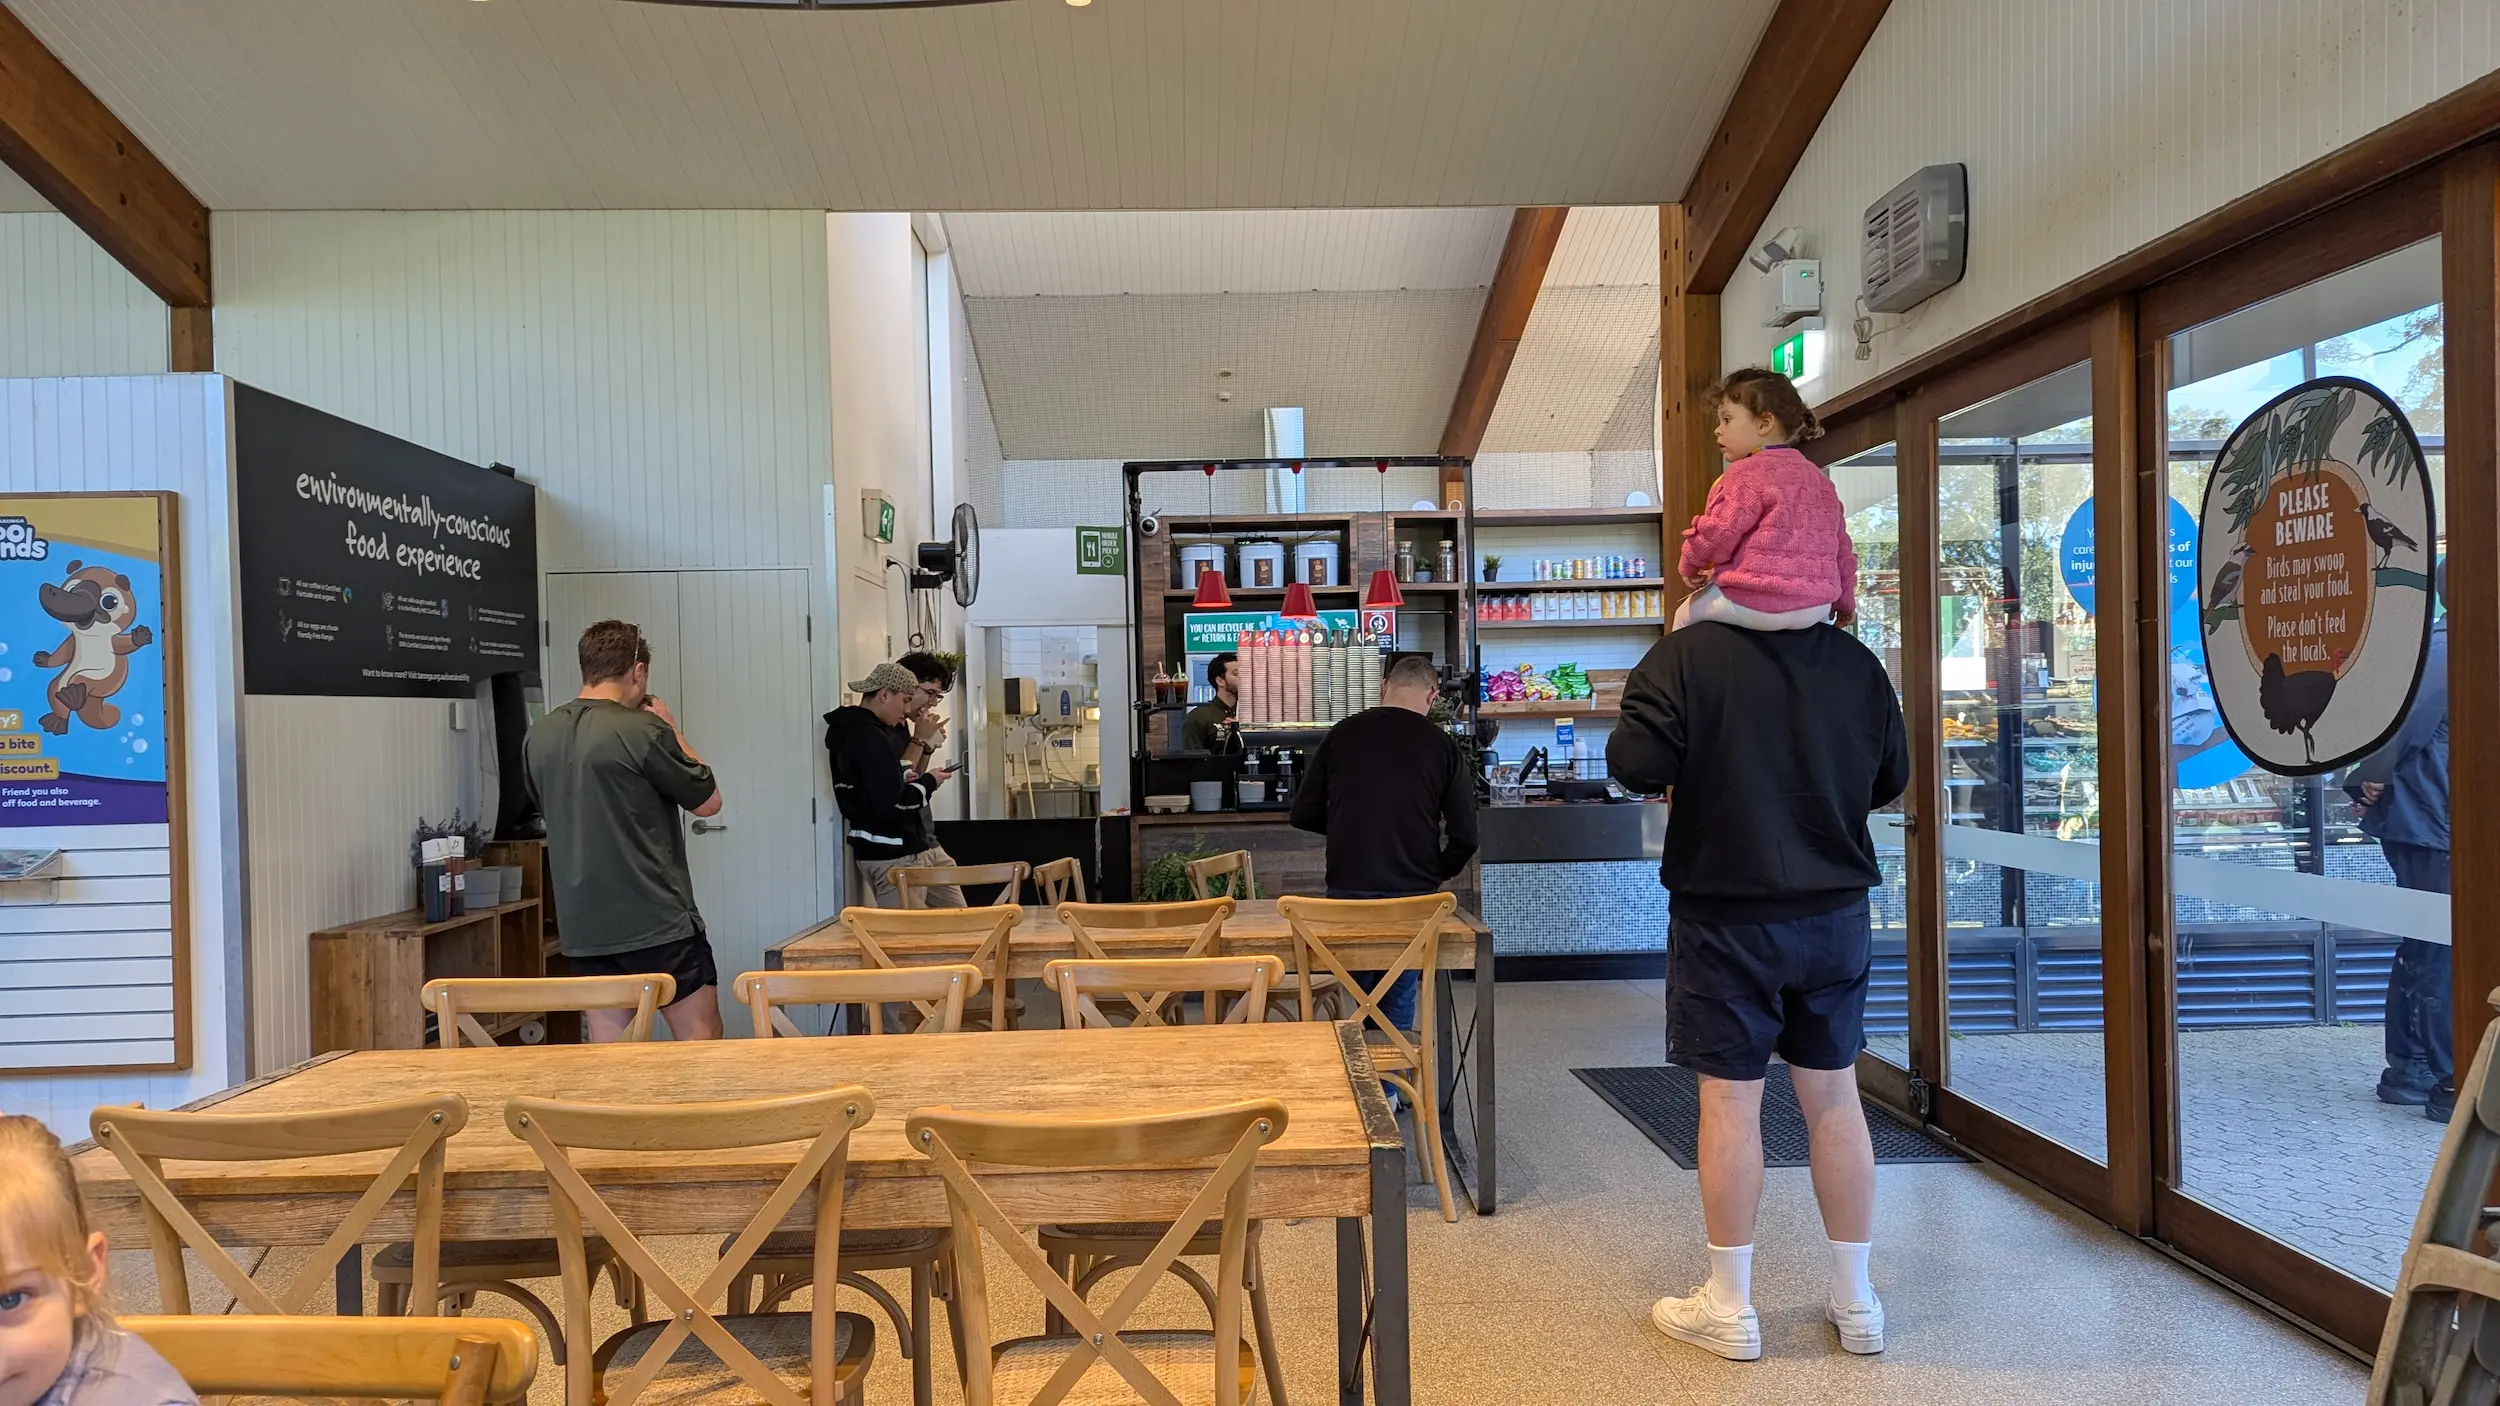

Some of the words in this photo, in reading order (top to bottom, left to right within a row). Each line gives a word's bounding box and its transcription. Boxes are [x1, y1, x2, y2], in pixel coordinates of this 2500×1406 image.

[2279, 482, 2330, 517] PLEASE
[296, 471, 511, 549] environmentally-conscious
[1102, 532, 1118, 540] MOBILE
[2275, 511, 2335, 547] BEWARE
[345, 520, 390, 561] food
[396, 543, 482, 581] experience
[2178, 540, 2192, 552] of
[2175, 559, 2194, 568] our
[2266, 554, 2291, 580] Birds
[2292, 555, 2312, 578] may
[2314, 552, 2345, 575] swoop
[2260, 580, 2277, 605] and
[2279, 578, 2301, 604] steal
[2303, 581, 2325, 604] your
[2327, 571, 2353, 598] food.
[1190, 624, 1203, 633] YOU
[1204, 623, 1216, 633] CAN
[1217, 622, 1244, 633] RECYCLE
[1245, 622, 1255, 631] ME
[2267, 615, 2296, 639] Please
[2298, 610, 2324, 637] don't
[2325, 608, 2346, 634] feed
[1202, 633, 1226, 643] RETURN
[1227, 633, 1233, 642] &
[2282, 639, 2298, 663] the
[2300, 637, 2331, 662] locals.
[9, 738, 35, 749] bite
[2, 788, 30, 796] Friend
[50, 787, 68, 795] also
[2, 799, 16, 807] off
[17, 798, 37, 807] food
[39, 798, 57, 806] and
[58, 798, 101, 807] beverage.
